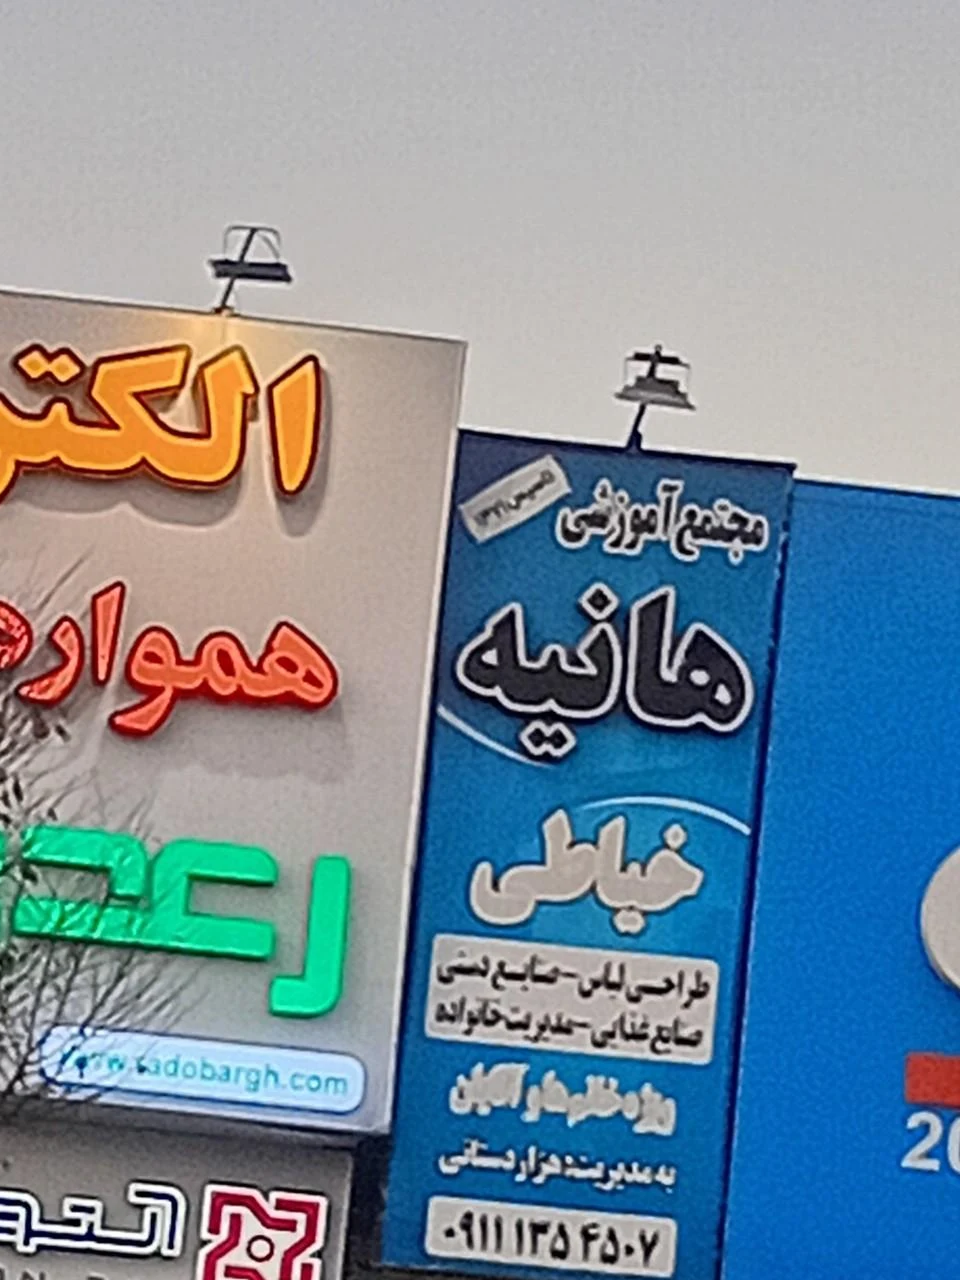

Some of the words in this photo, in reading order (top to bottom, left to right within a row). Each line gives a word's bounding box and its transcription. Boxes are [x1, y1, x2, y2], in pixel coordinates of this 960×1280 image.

[555, 477, 684, 553] آموزشی
[672, 499, 770, 567] مجتمع
[455, 581, 755, 759] هانیه
[469, 808, 705, 935] خیاطی
[578, 960, 627, 999] لباس
[626, 966, 711, 1009] طراحی
